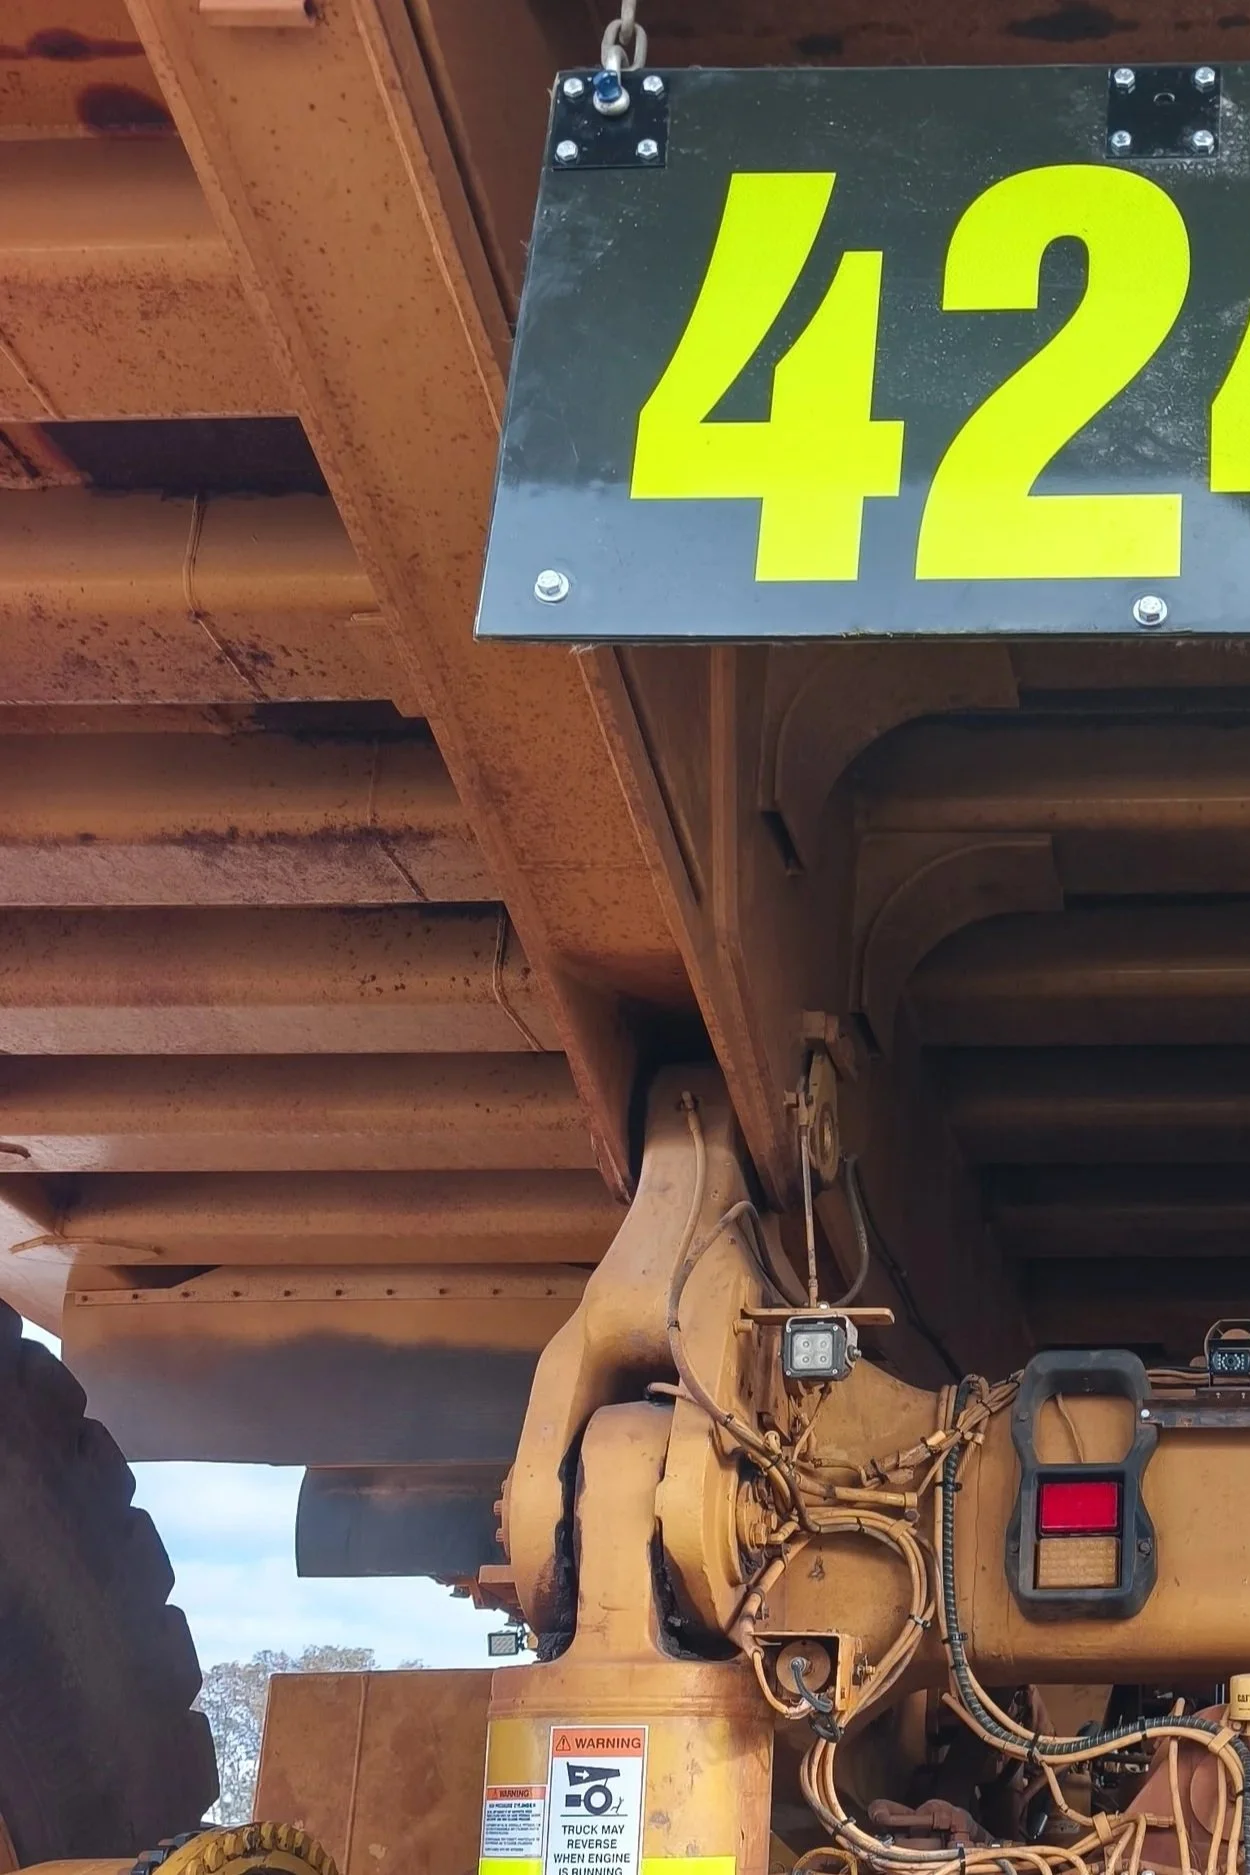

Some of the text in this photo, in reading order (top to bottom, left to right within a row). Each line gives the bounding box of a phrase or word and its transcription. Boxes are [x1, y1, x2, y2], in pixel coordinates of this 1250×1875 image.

[575, 1737, 642, 1749] WARNING
[499, 1789, 529, 1798] WARNING
[562, 1824, 625, 1835] TRUCK MAY
[567, 1839, 617, 1849] REVERSE
[553, 1853, 631, 1863] WHEN ENGINE
[559, 1867, 623, 1875] IS RUNNING
